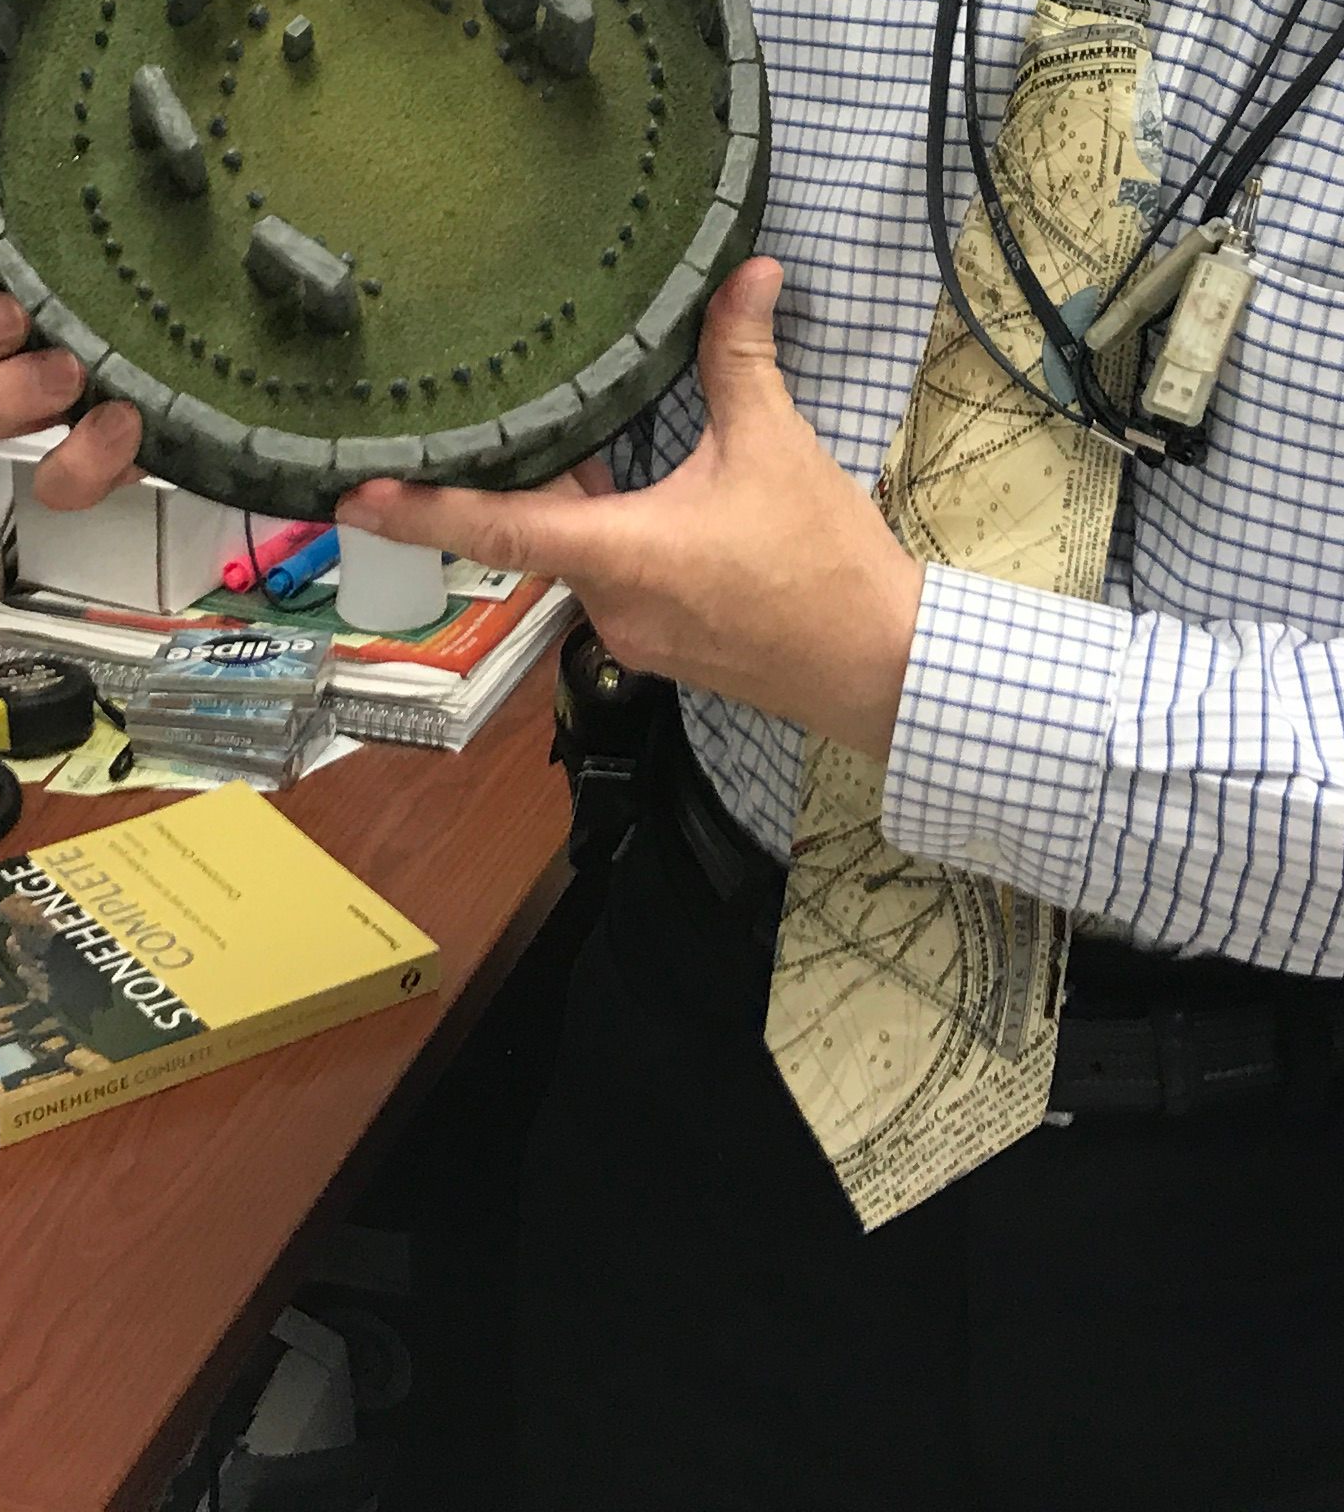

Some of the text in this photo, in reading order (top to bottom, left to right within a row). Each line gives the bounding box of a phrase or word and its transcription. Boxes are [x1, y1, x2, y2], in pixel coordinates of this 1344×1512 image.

[164, 634, 317, 664] eclipse
[44, 845, 195, 970] COMPLETE
[13, 1045, 214, 1130] STONEHENGE COMPLETE
